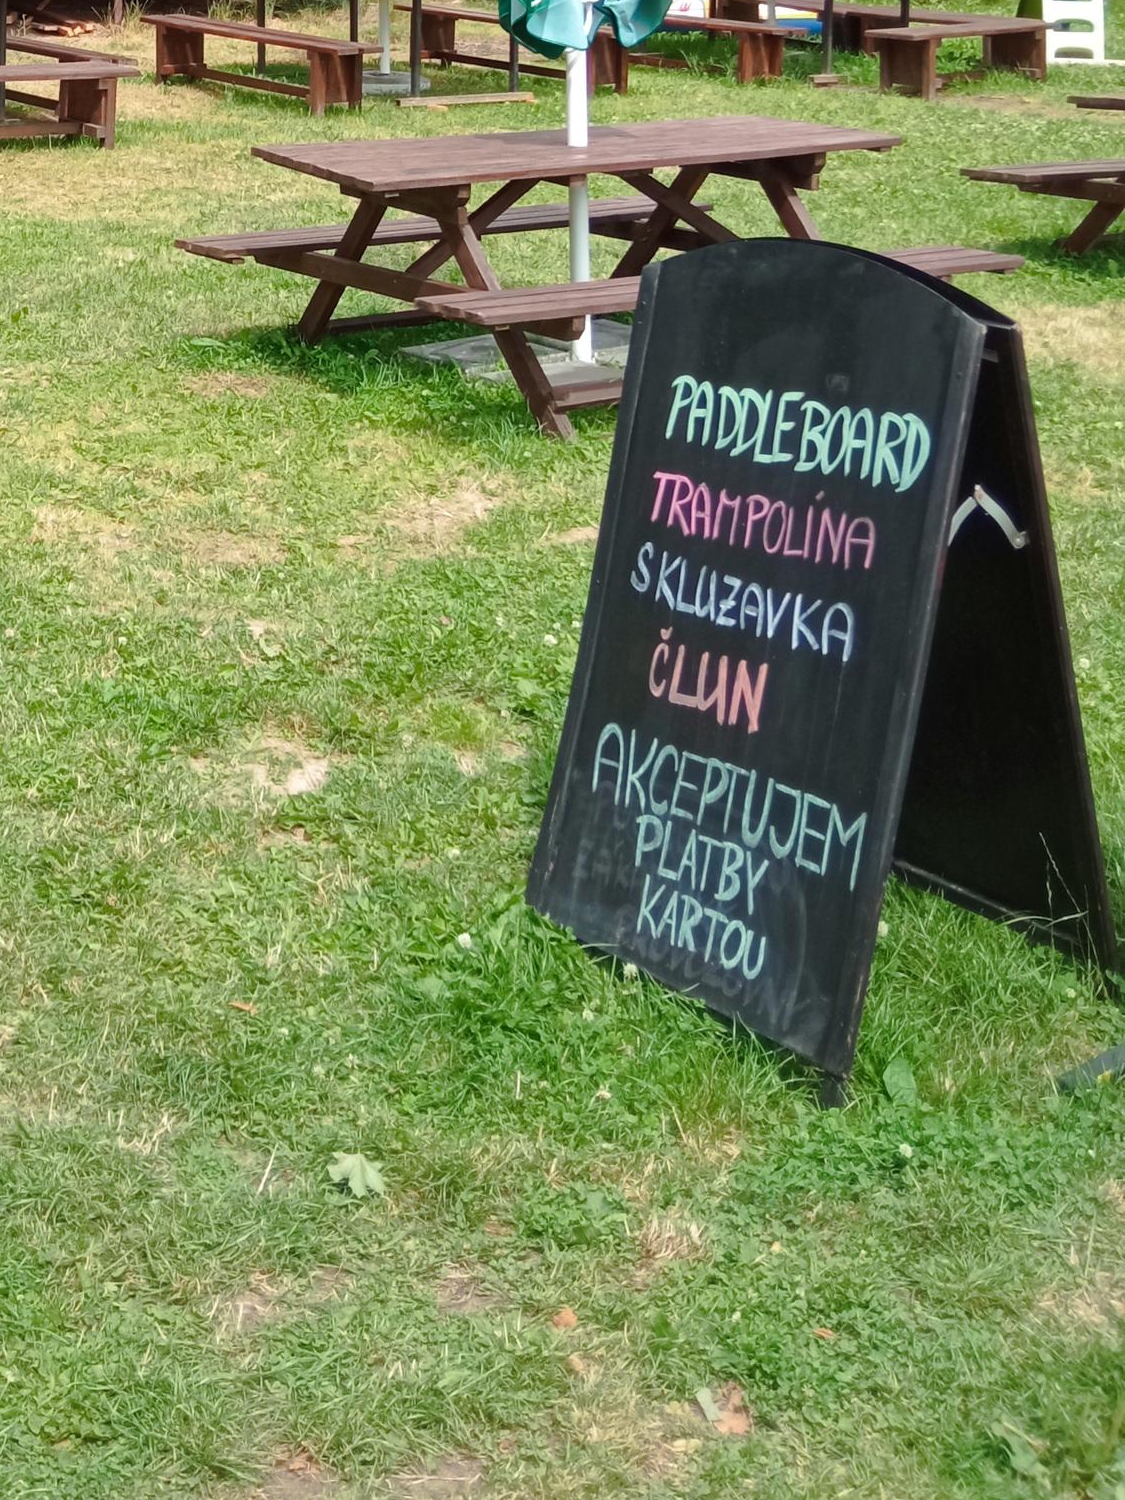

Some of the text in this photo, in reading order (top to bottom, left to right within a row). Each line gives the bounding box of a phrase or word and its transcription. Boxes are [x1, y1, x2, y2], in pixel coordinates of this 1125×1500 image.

[665, 374, 932, 493] PADDLEBOARD
[649, 471, 877, 570] TRAMPOLÍNA
[630, 541, 856, 663] SKLUZAVKA
[648, 629, 770, 734] ČLUN
[592, 722, 869, 893] AKCEPTUJEM
[635, 814, 770, 916] PLATBY
[636, 873, 768, 981] KARTOU
